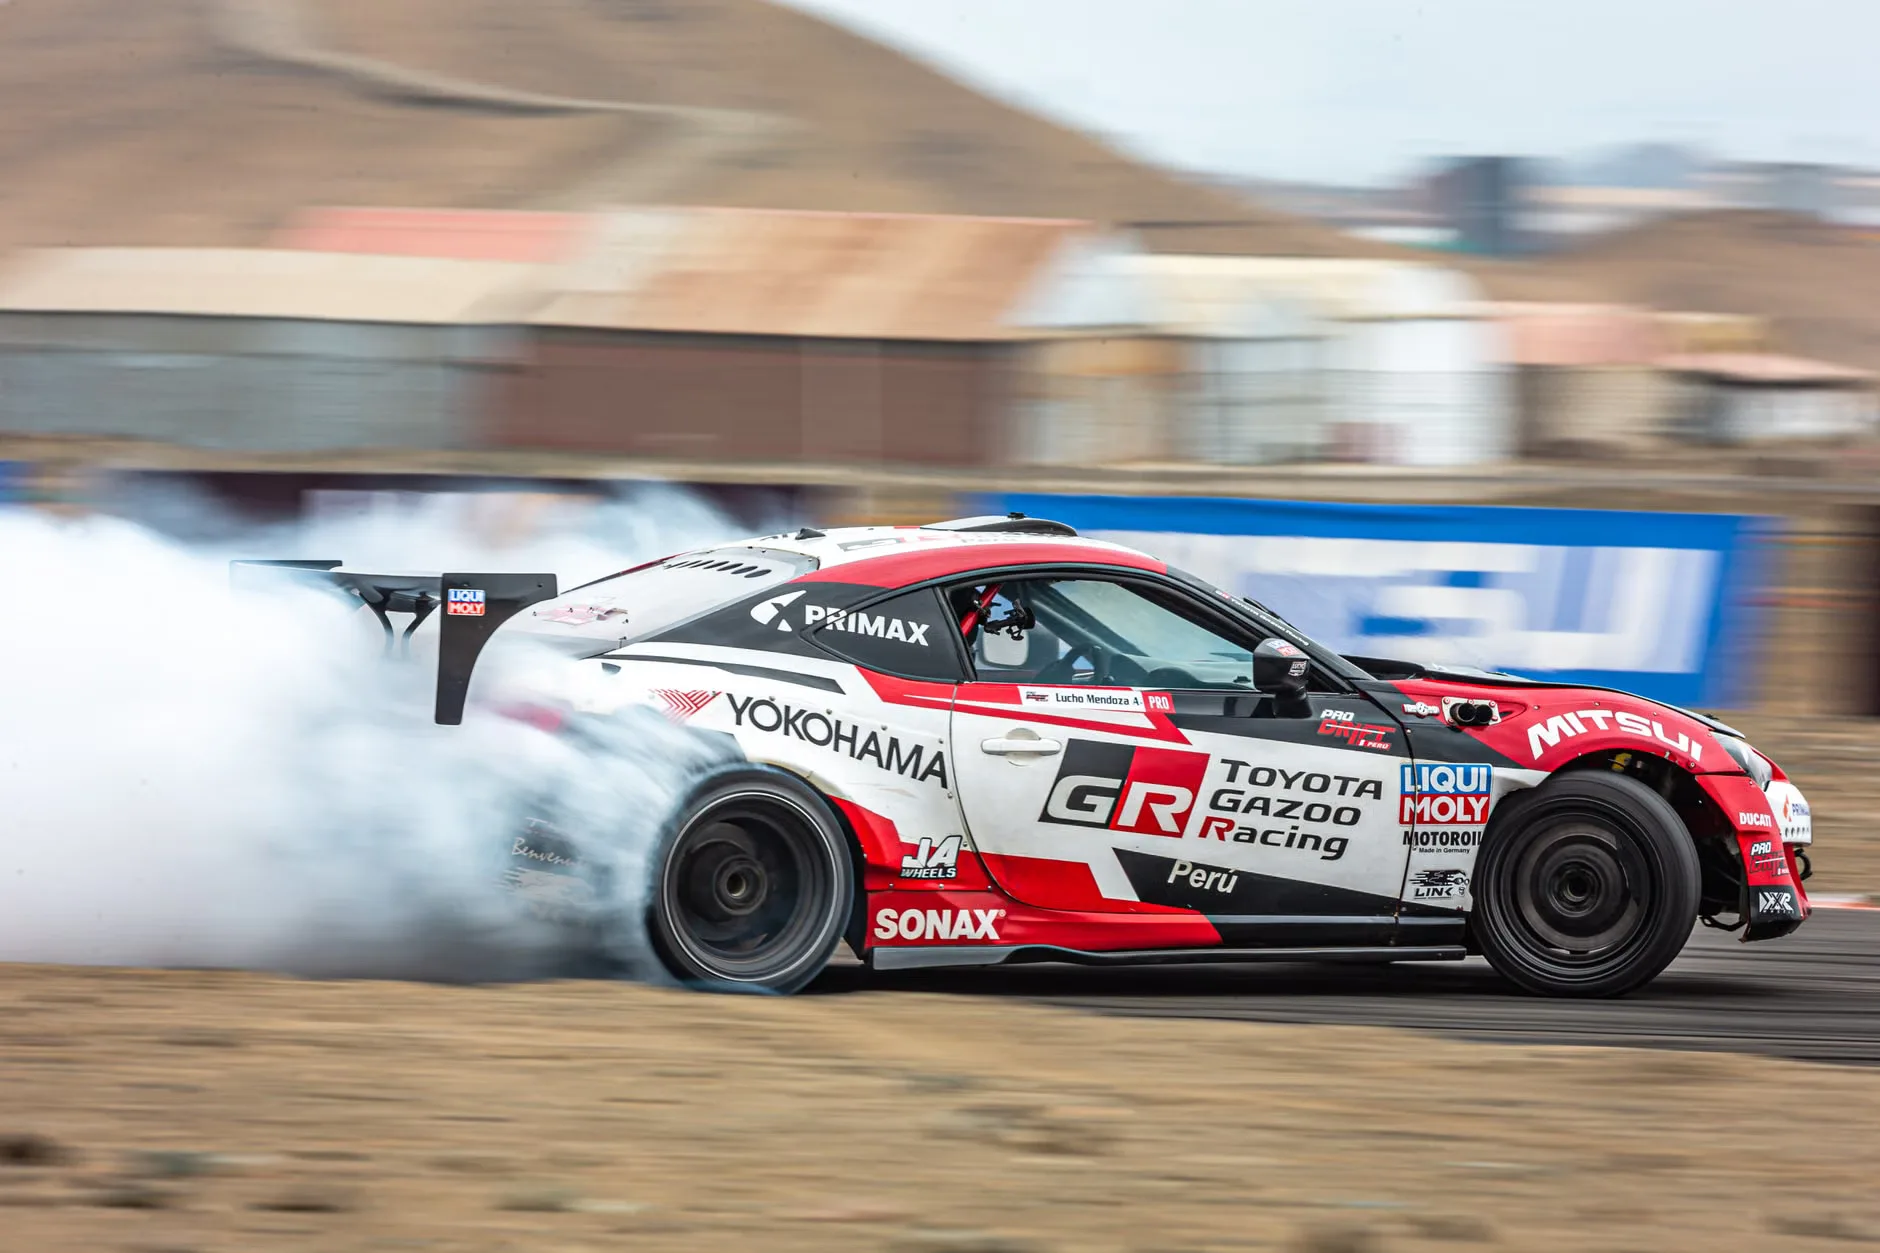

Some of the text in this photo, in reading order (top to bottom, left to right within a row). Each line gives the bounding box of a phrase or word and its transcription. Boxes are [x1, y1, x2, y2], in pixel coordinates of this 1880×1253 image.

[450, 590, 484, 602] LIQUI
[450, 602, 484, 614] MOLY
[804, 604, 931, 647] PRIMAX
[1055, 693, 1084, 704] Lucho
[1086, 694, 1130, 706] Mendoza
[1148, 695, 1170, 710] PRO
[1320, 709, 1355, 722] PRO
[726, 692, 949, 790] YOKOHAMA
[1317, 719, 1397, 745] DRIFT
[1527, 709, 1703, 761] MITSUI
[1404, 765, 1488, 794] LIQUI
[1045, 774, 1196, 834] GR
[1208, 788, 1362, 827] GAZOO
[1403, 795, 1489, 823] MOLY
[1739, 811, 1772, 828] DUCATI
[1198, 815, 1350, 862] Racing
[1418, 846, 1436, 854] Made
[1443, 846, 1470, 855] Germany
[1750, 841, 1772, 856] PRO
[901, 835, 963, 869] JA
[900, 867, 957, 879] WHEELS
[1167, 859, 1239, 895] Perú
[1414, 887, 1454, 897] LINK
